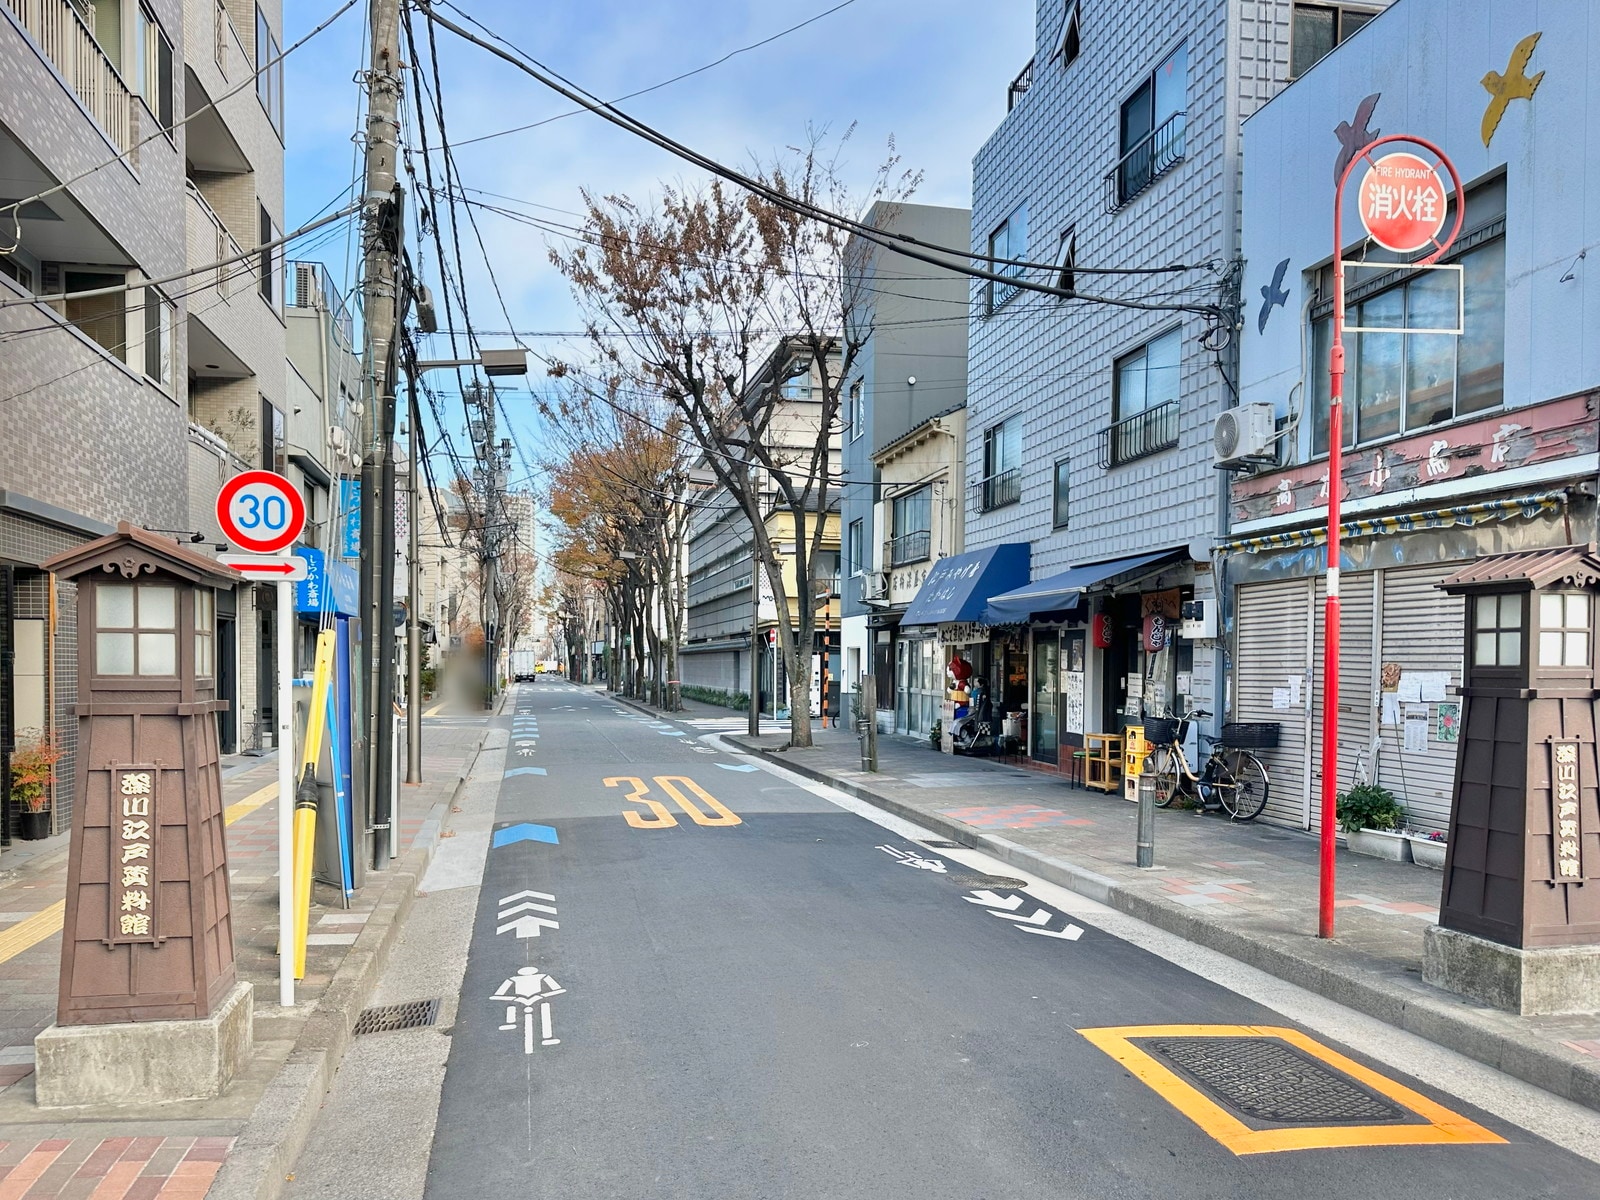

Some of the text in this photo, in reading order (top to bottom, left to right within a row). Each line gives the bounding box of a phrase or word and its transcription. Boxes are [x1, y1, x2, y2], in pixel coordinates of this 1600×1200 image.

[1375, 166, 1431, 180] FIRE HYDRANT
[1367, 182, 1439, 222] 消火栓
[237, 493, 287, 531] 30
[306, 554, 319, 607] しらかわ斎場
[1150, 616, 1165, 648] もんじゃ
[602, 775, 743, 829] 30
